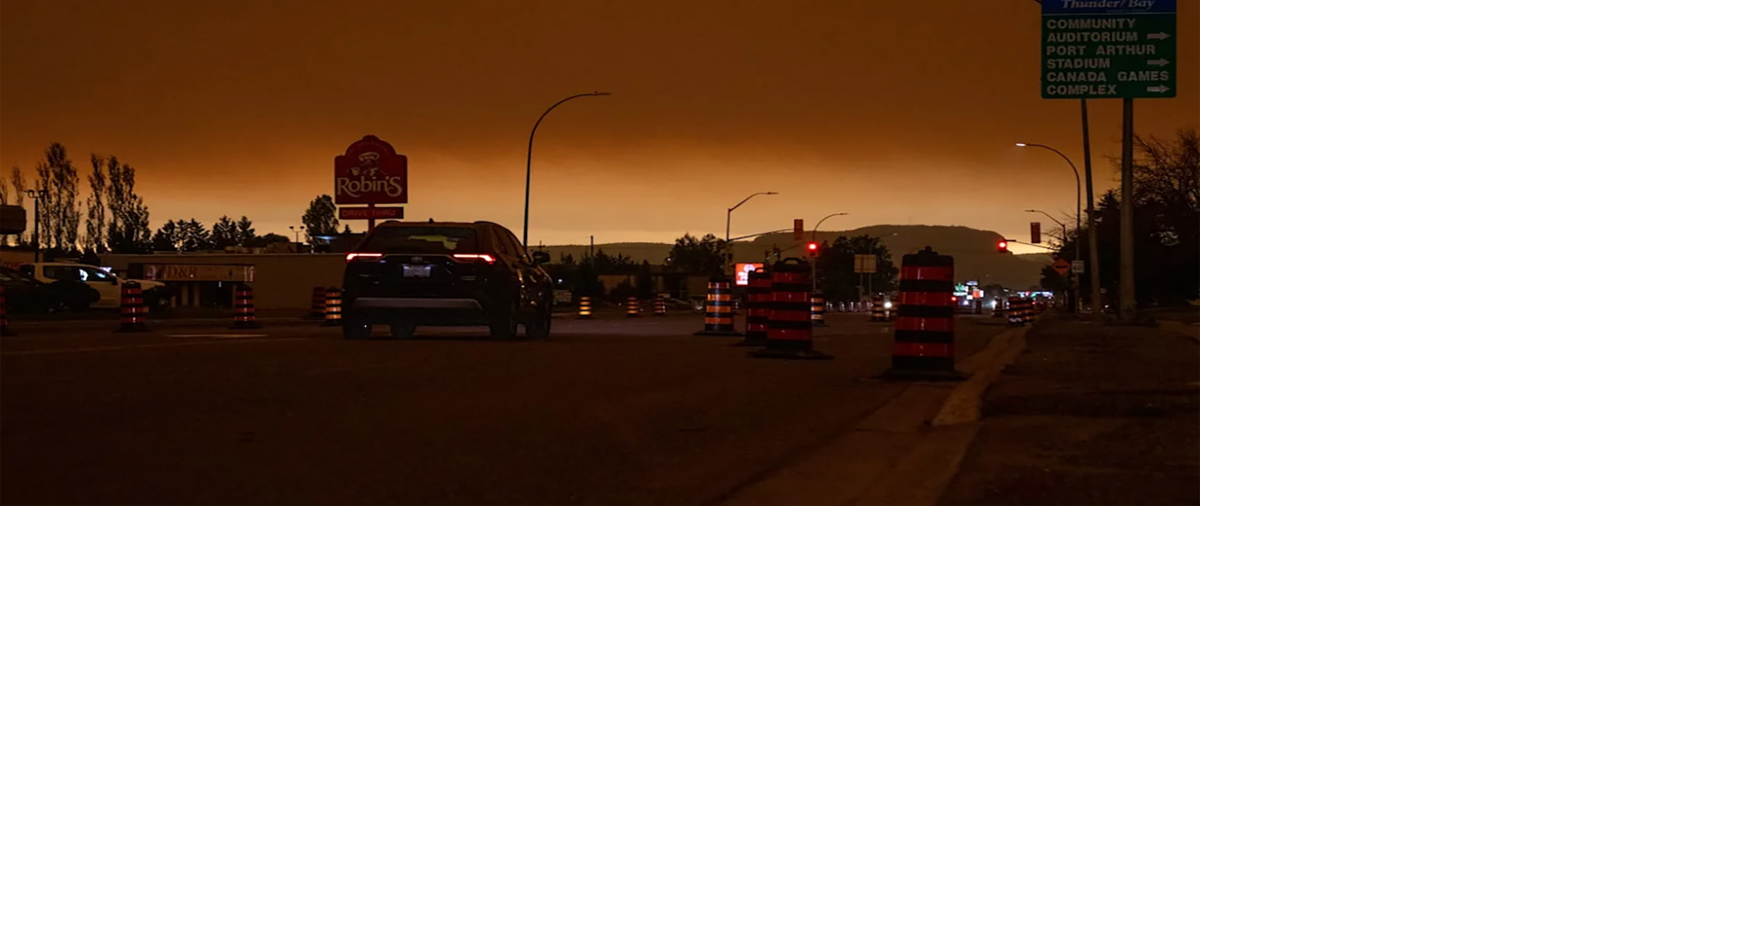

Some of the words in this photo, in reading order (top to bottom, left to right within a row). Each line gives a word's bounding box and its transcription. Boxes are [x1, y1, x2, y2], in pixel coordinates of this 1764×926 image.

[1046, 18, 1136, 29] COMMUNITY
[1046, 31, 1138, 42] AUDITORIUM
[1046, 45, 1086, 56] PORT
[1095, 44, 1156, 55] ARTHUR
[1046, 58, 1110, 69] STADIUM
[1046, 72, 1107, 82] CANADA
[1117, 71, 1169, 81] GAMES
[1046, 84, 1117, 95] COMPLEX
